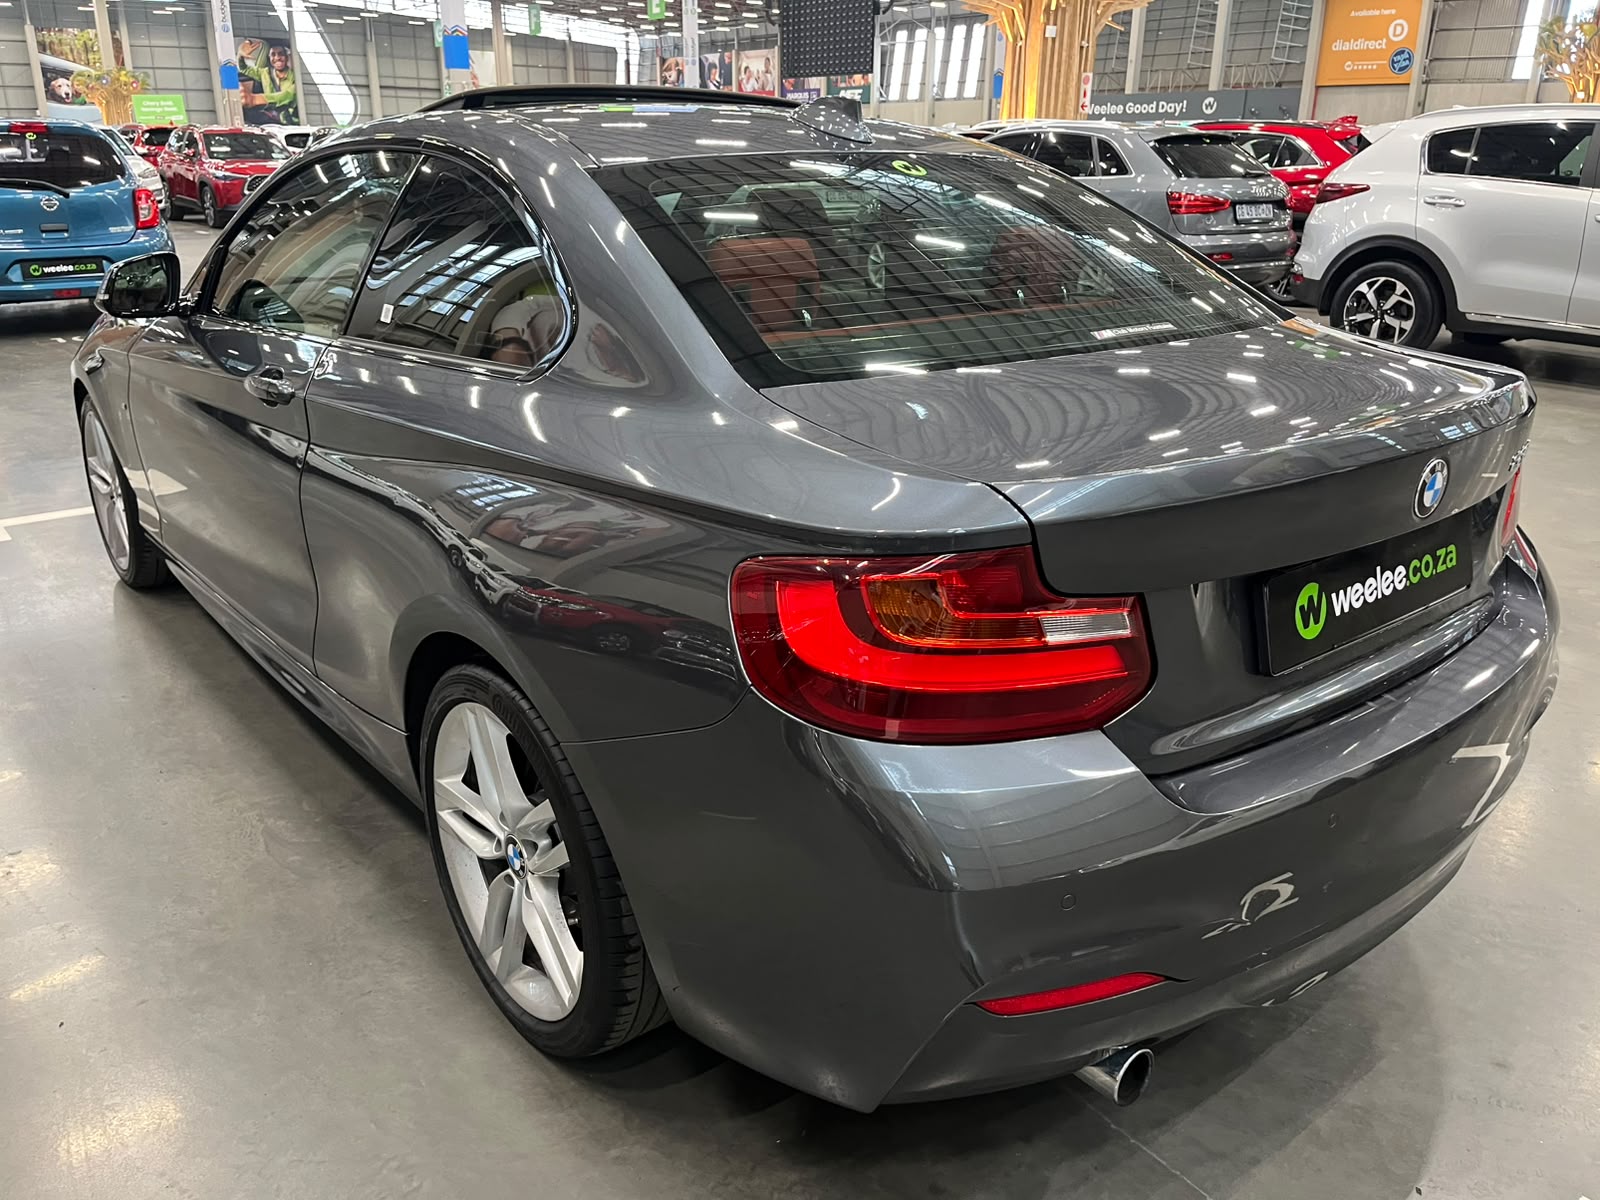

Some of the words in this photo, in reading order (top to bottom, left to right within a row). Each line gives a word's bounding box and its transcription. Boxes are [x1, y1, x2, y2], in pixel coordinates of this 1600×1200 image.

[1350, 9, 1380, 17] Available
[1331, 38, 1387, 51] dialdirect
[1125, 101, 1157, 114] Good
[1158, 99, 1187, 117] Day!
[43, 263, 97, 273] weelee.co.za
[1331, 544, 1457, 616] weelee.co.za
